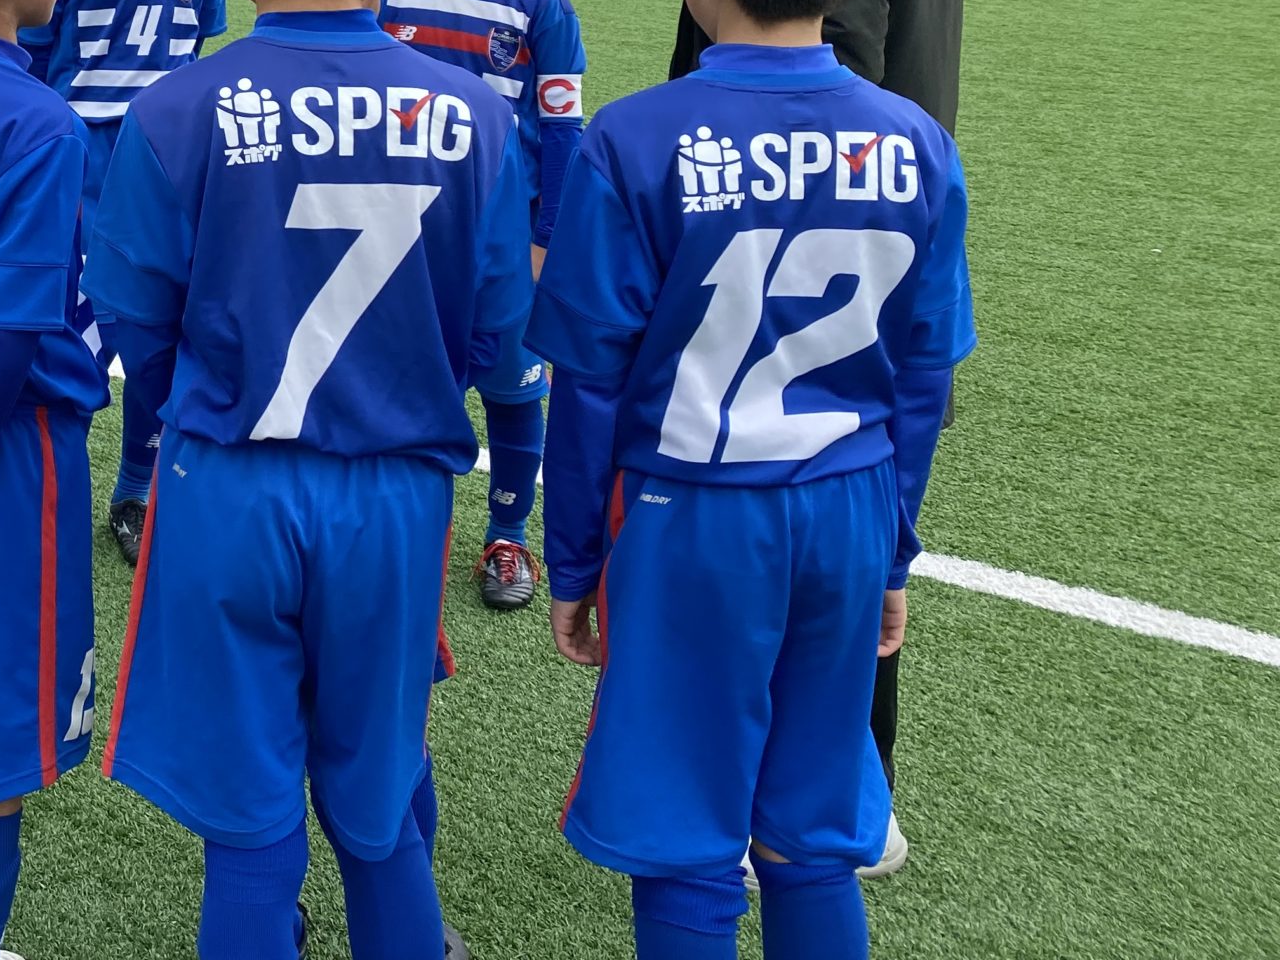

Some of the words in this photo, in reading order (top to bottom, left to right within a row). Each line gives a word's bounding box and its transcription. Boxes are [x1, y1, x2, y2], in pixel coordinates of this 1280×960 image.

[125, 4, 163, 56] 4
[539, 78, 577, 115] C
[224, 143, 283, 167] スポグ
[681, 192, 746, 214] スポグ
[248, 183, 443, 441] 7
[656, 228, 916, 464] 12
[63, 647, 96, 742] 1
